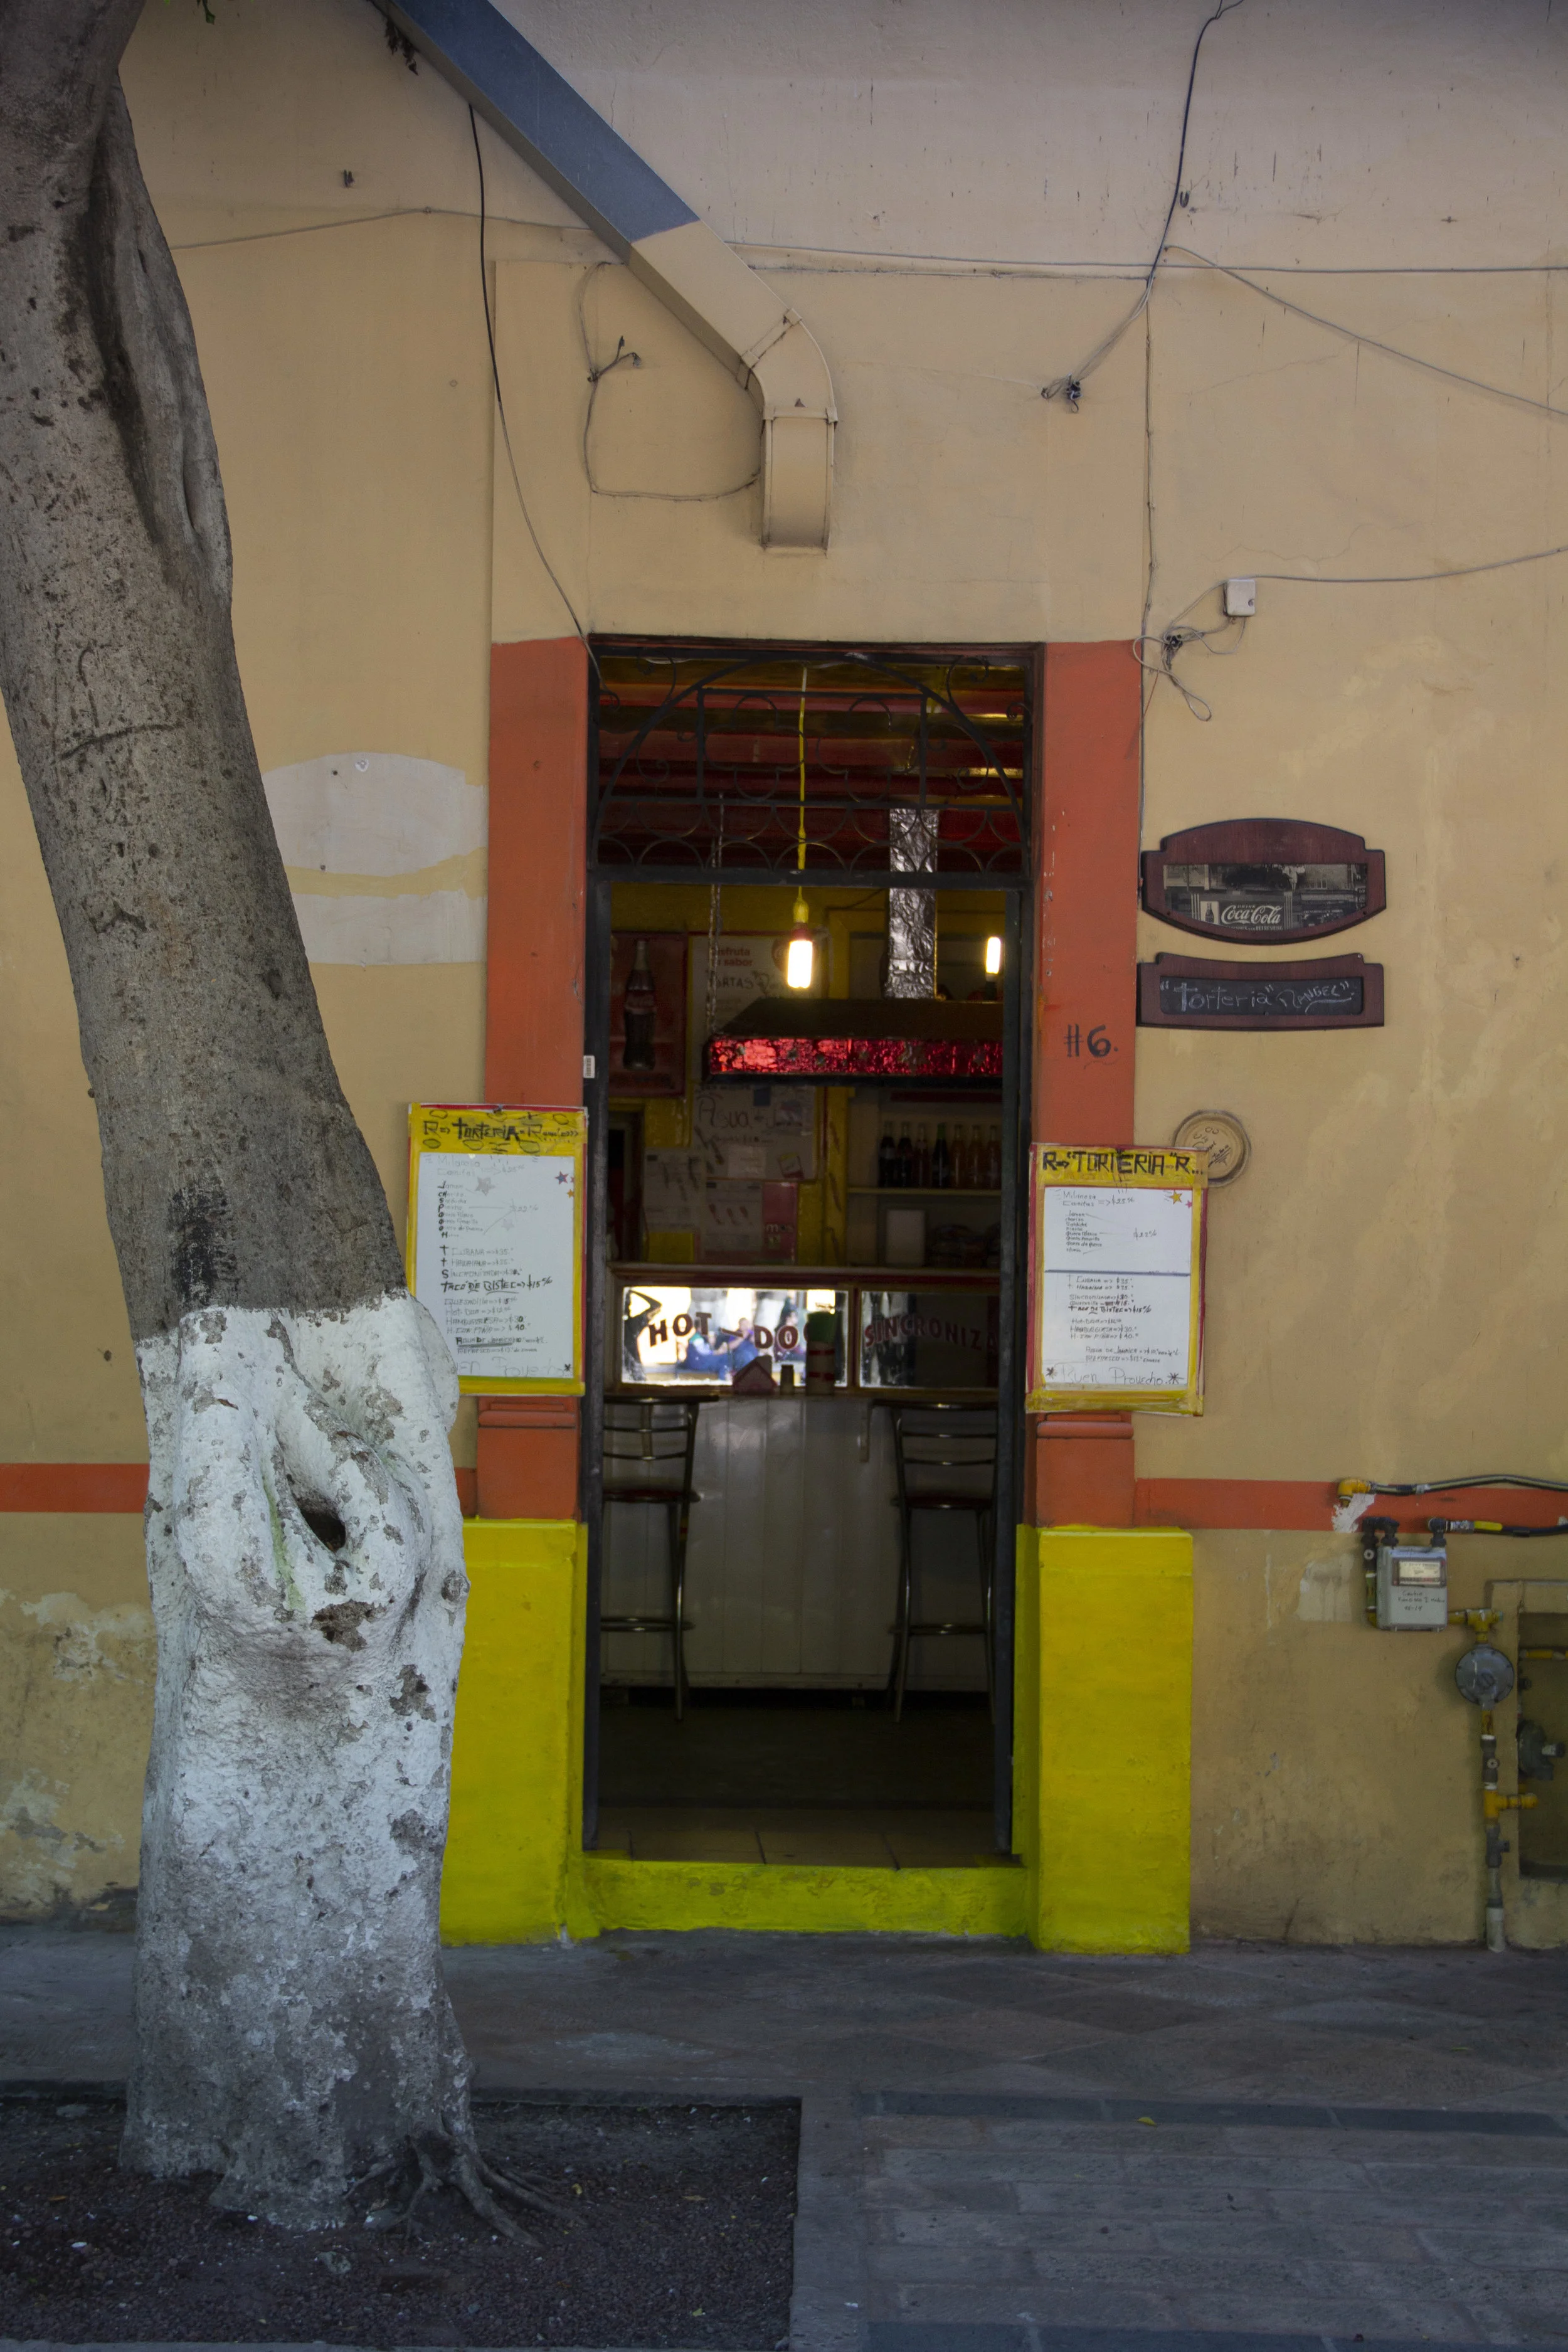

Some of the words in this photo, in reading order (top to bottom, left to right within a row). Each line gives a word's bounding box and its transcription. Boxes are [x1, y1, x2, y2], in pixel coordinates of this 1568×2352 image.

[724, 958, 753, 967] sabor
[649, 1311, 712, 1347] HOT
[754, 1325, 808, 1350] DO
